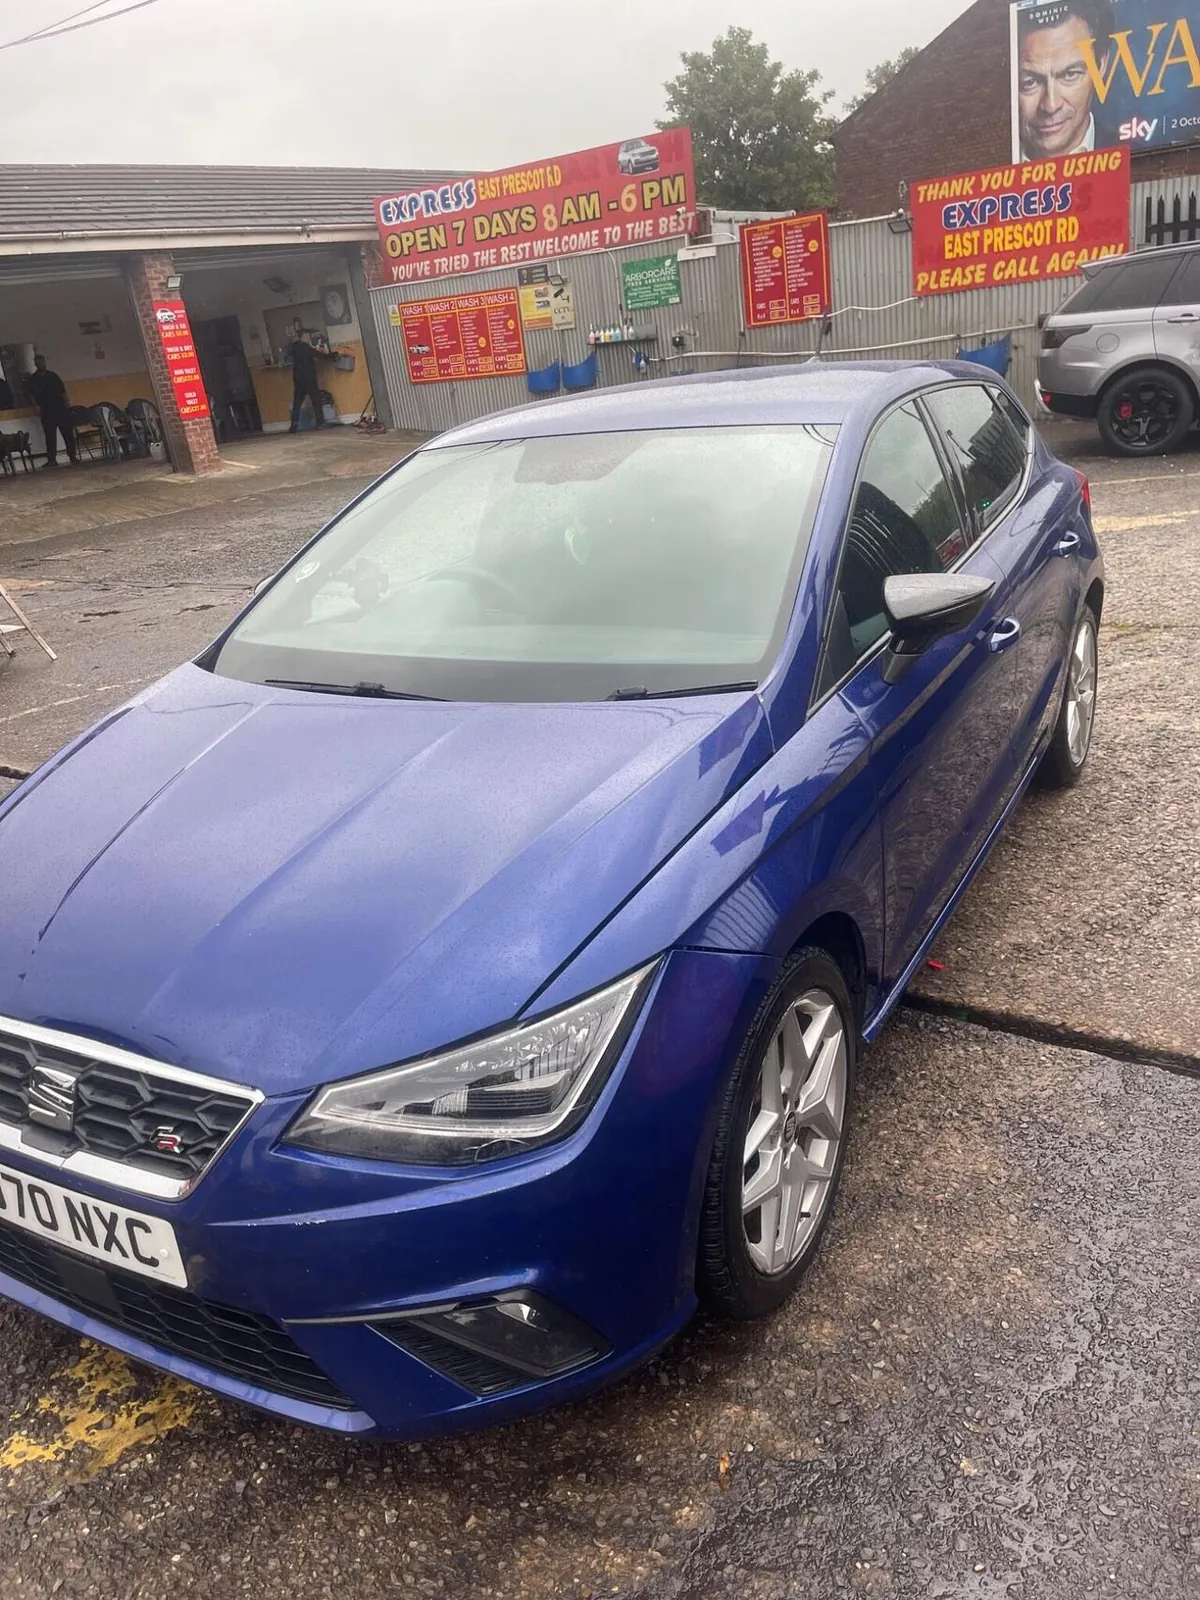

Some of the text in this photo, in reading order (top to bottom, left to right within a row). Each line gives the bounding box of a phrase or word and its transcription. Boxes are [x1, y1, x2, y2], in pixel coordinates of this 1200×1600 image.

[1029, 5, 1069, 20] DOMINIC
[1038, 14, 1060, 25] WEST
[1119, 117, 1158, 141] sky
[1171, 119, 1178, 129] 2
[917, 150, 1122, 204] THANK YOU FOR USING
[380, 179, 477, 226] EXPRESS
[477, 175, 501, 201] EAST
[501, 167, 545, 197] PRESCOT
[547, 164, 562, 189] RD
[942, 182, 1073, 230] EXPRESS
[385, 224, 448, 259] OPEN
[452, 219, 466, 246] 7
[473, 204, 538, 242] DAYS
[542, 203, 558, 232] 8
[560, 191, 602, 227] AM
[620, 183, 637, 213] 6
[641, 173, 686, 210] PM
[391, 211, 697, 281] YOU'VE TRIED THE REST WELCOME TO THE BEST
[944, 215, 1080, 260] EAST PRESCOT RD
[625, 265, 677, 282] ARBORCARE
[916, 263, 987, 292] PLEASE
[992, 255, 1040, 281] CALL
[428, 300, 455, 313] WASH 2
[458, 296, 485, 309] WASH 3
[487, 293, 508, 304] WASH
[509, 292, 515, 301] 4
[402, 305, 423, 316] WASH
[0, 1172, 160, 1268] 70 NXC
